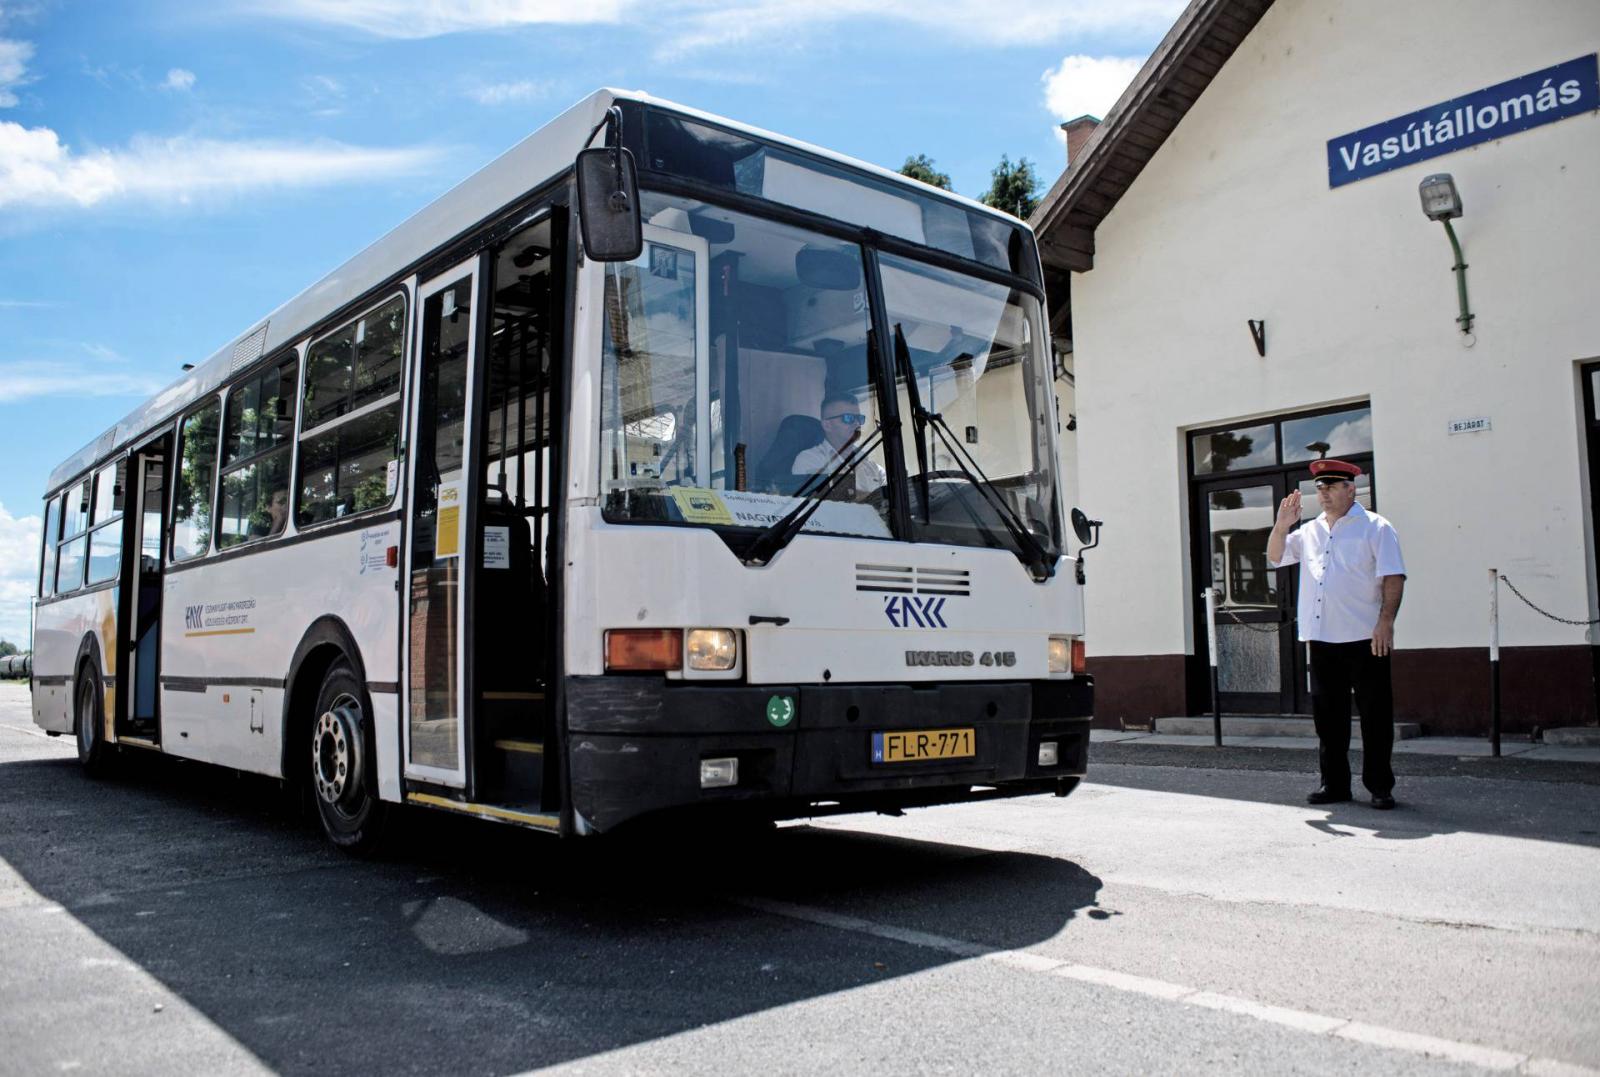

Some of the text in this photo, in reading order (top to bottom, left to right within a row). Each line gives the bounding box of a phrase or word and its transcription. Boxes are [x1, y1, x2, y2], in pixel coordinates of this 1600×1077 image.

[1339, 79, 1582, 172] Vasútállomás
[905, 650, 1017, 667] IKARUS 415
[888, 732, 970, 759] FLR-771
